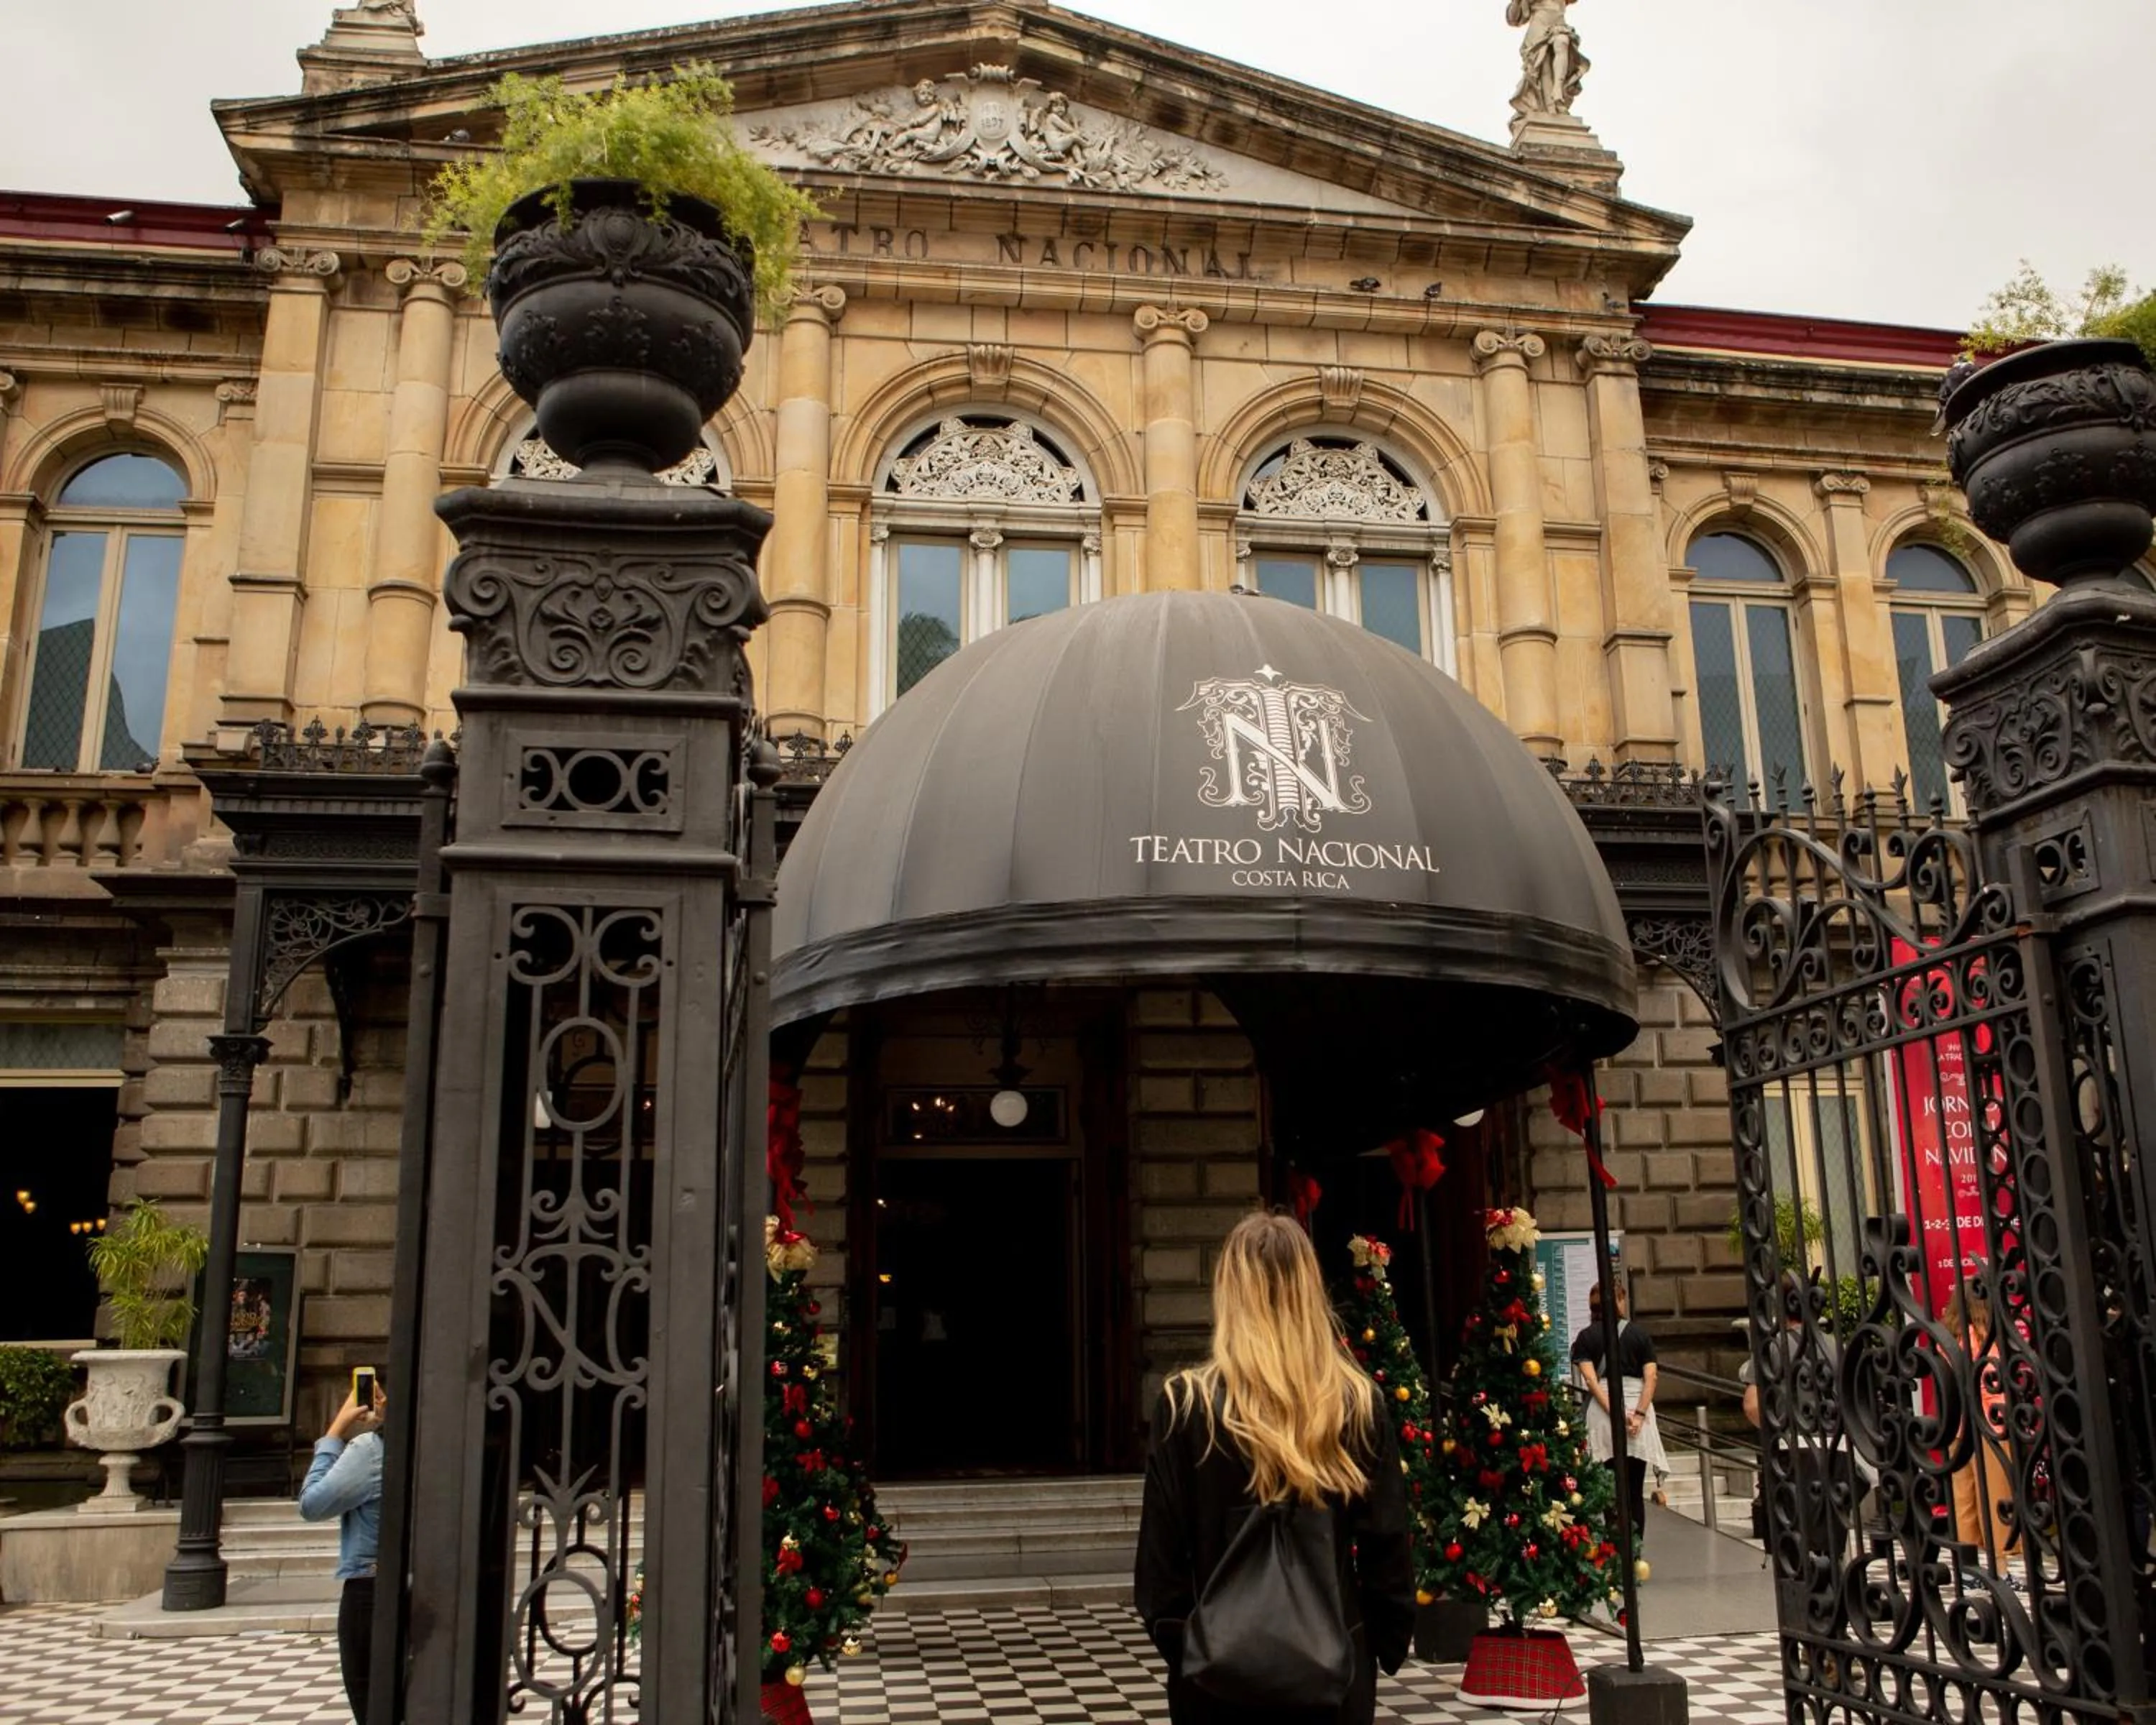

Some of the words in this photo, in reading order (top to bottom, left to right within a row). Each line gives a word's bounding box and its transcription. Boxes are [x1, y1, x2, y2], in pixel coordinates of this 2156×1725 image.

[796, 218, 929, 259] ATRO
[995, 234, 1263, 281] NACIONAL
[1130, 835, 1262, 865] TEATRO
[1278, 837, 1439, 873] NACIONAL
[1232, 870, 1295, 887] COSTA
[1303, 872, 1350, 890] RICA
[1956, 1216, 1971, 1228] DE
